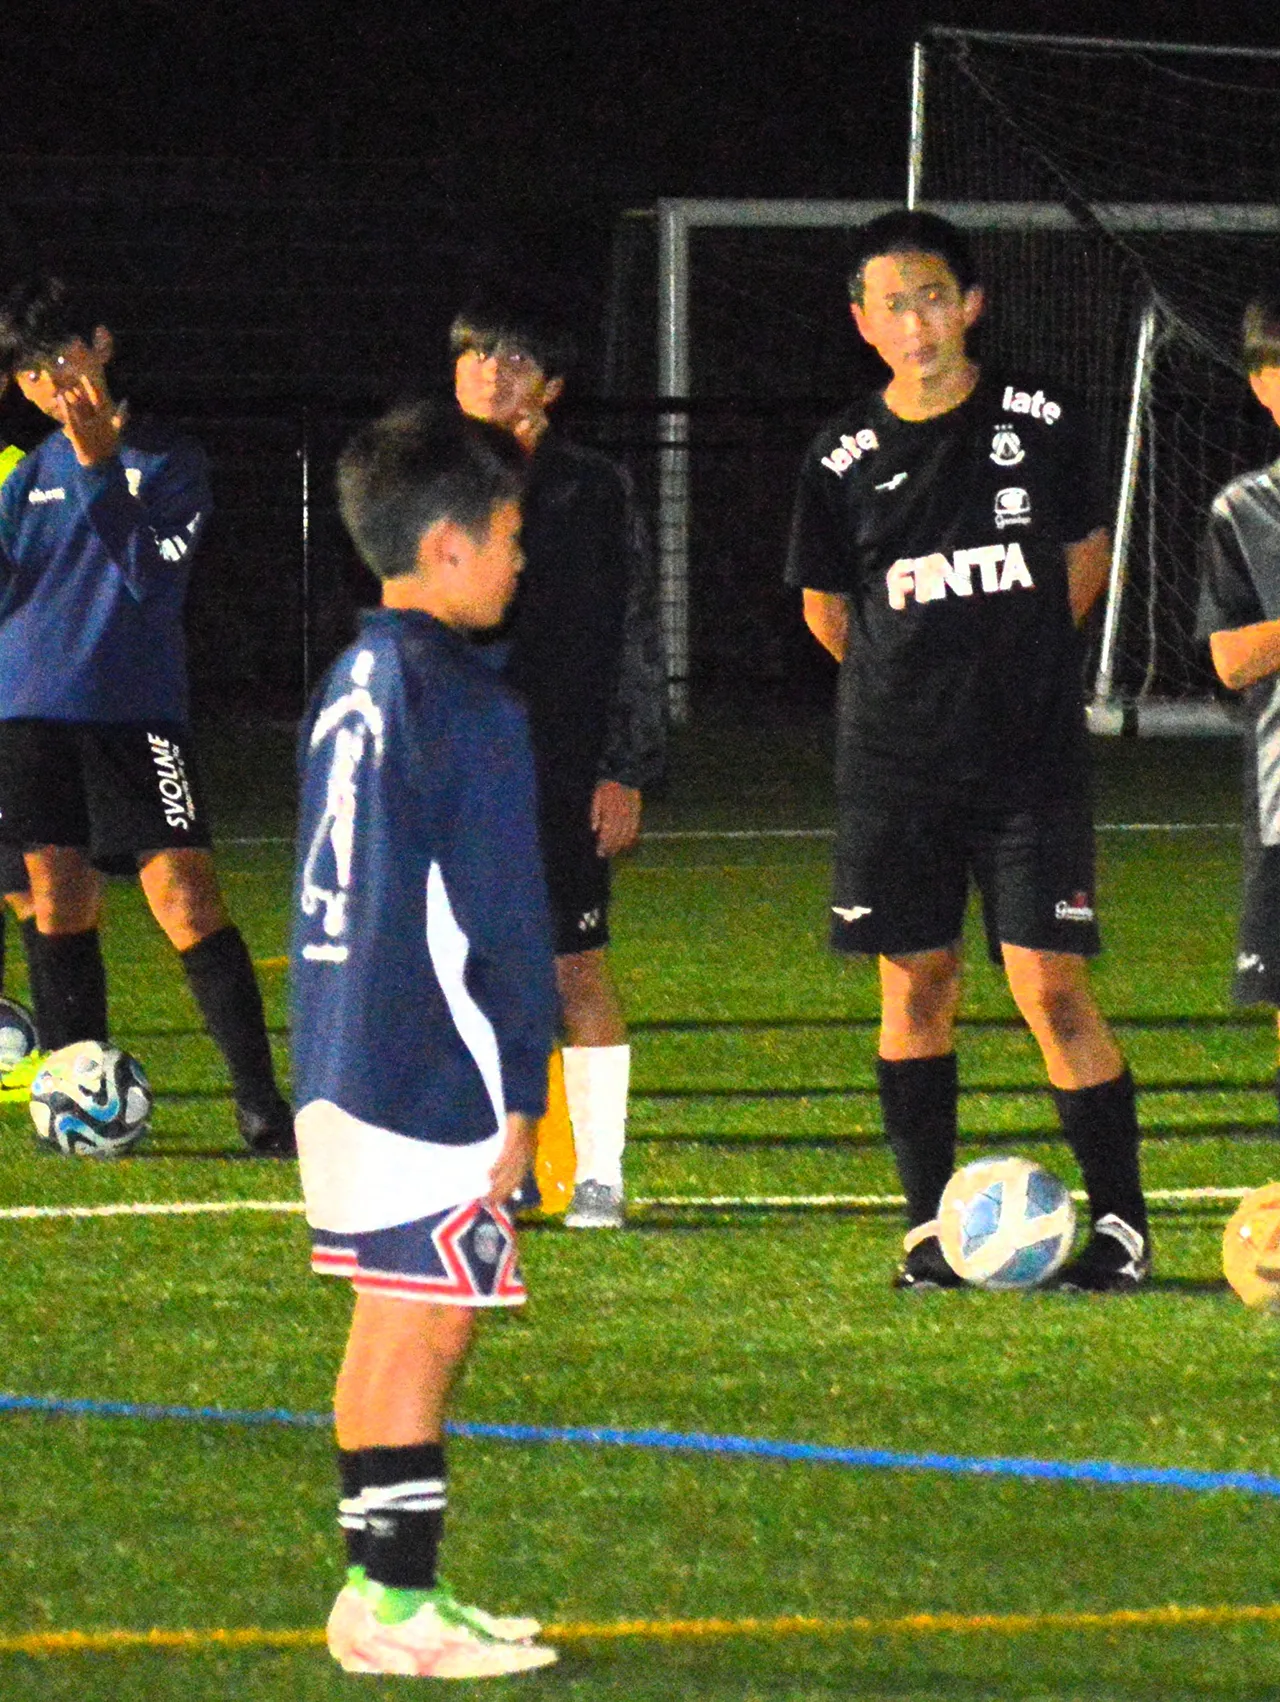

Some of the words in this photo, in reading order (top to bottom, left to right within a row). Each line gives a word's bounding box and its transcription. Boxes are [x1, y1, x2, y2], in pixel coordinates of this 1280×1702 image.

[1002, 386, 1061, 425] late
[886, 542, 1035, 611] FINTA
[146, 732, 189, 831] SVOLME
